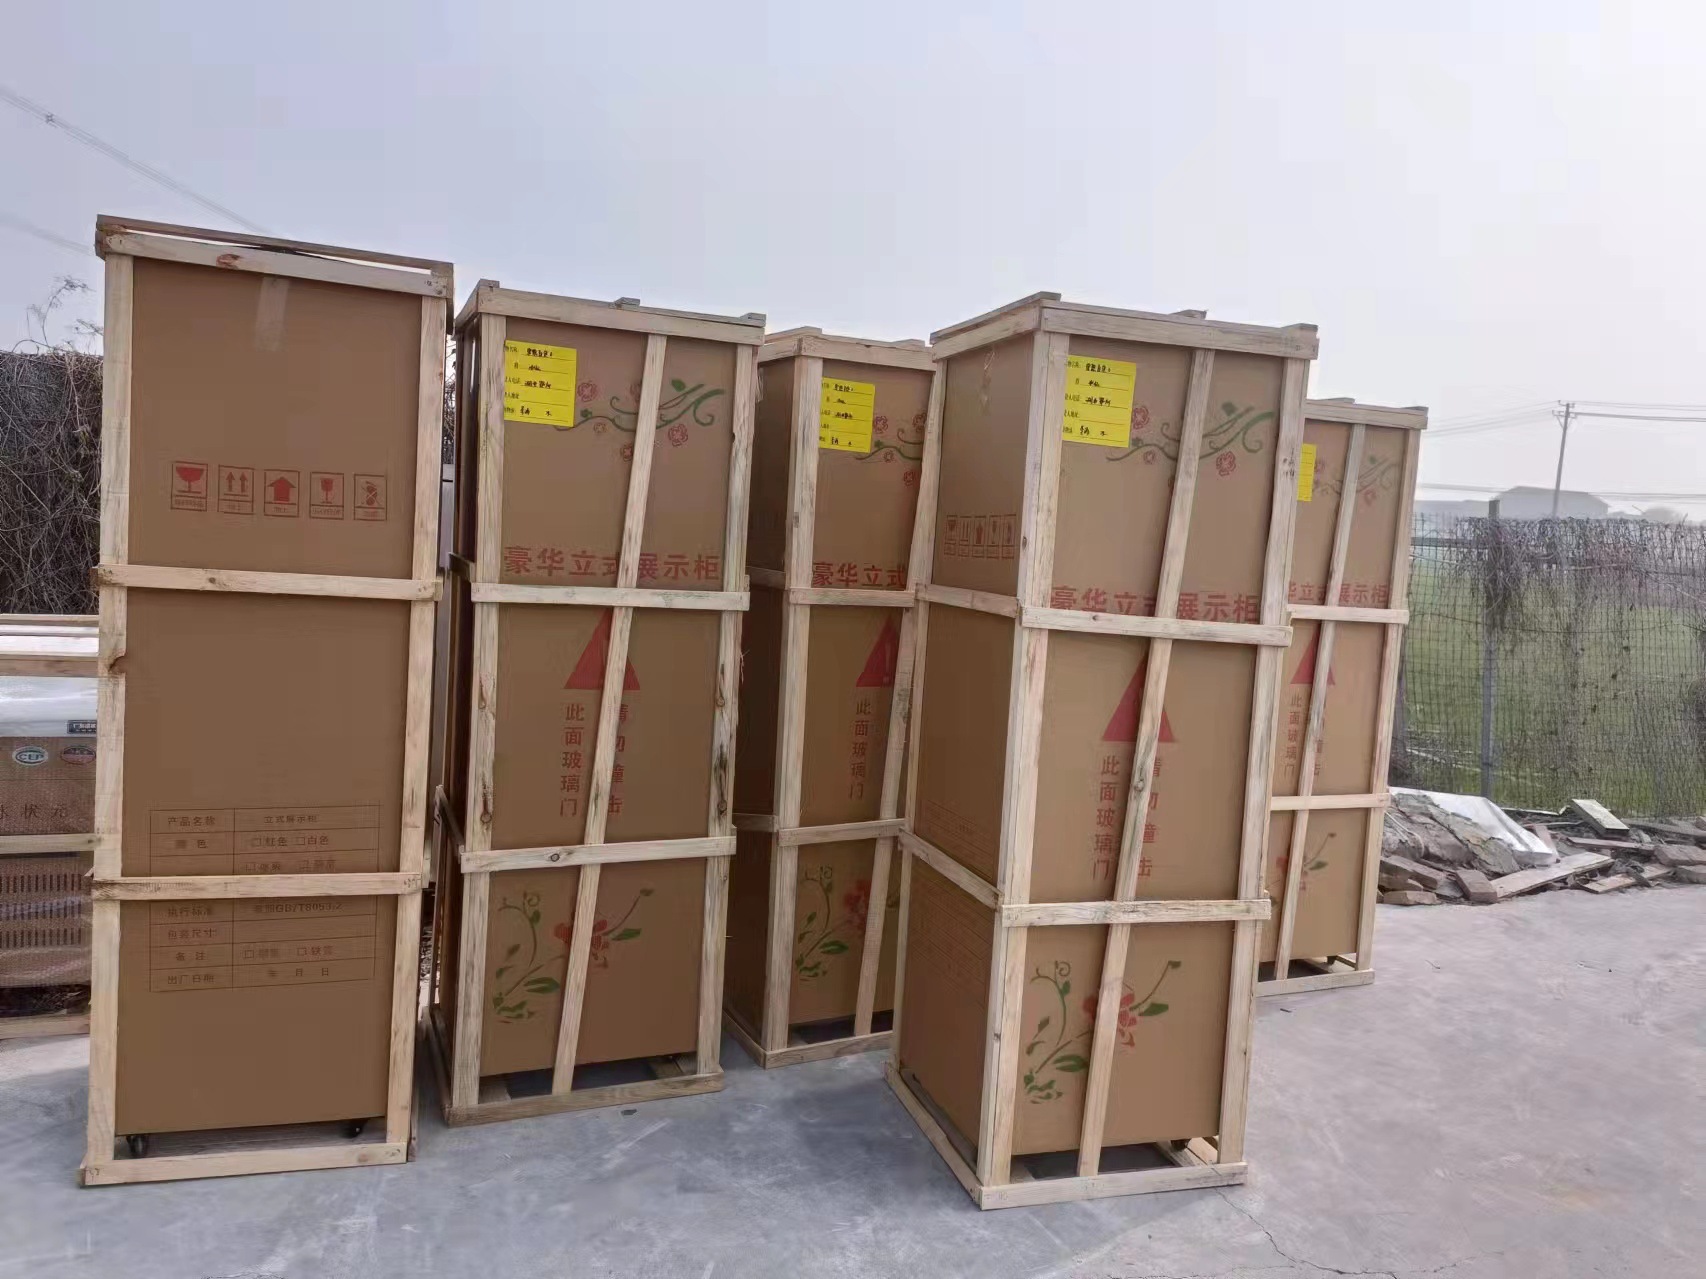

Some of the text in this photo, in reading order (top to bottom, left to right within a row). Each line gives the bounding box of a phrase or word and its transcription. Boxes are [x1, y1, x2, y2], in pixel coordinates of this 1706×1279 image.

[560, 703, 585, 817] 此面玻璃门
[848, 698, 872, 800] 此面玻璃门
[167, 815, 216, 828] 产品名称
[1092, 755, 1119, 880] 此面玻璃门
